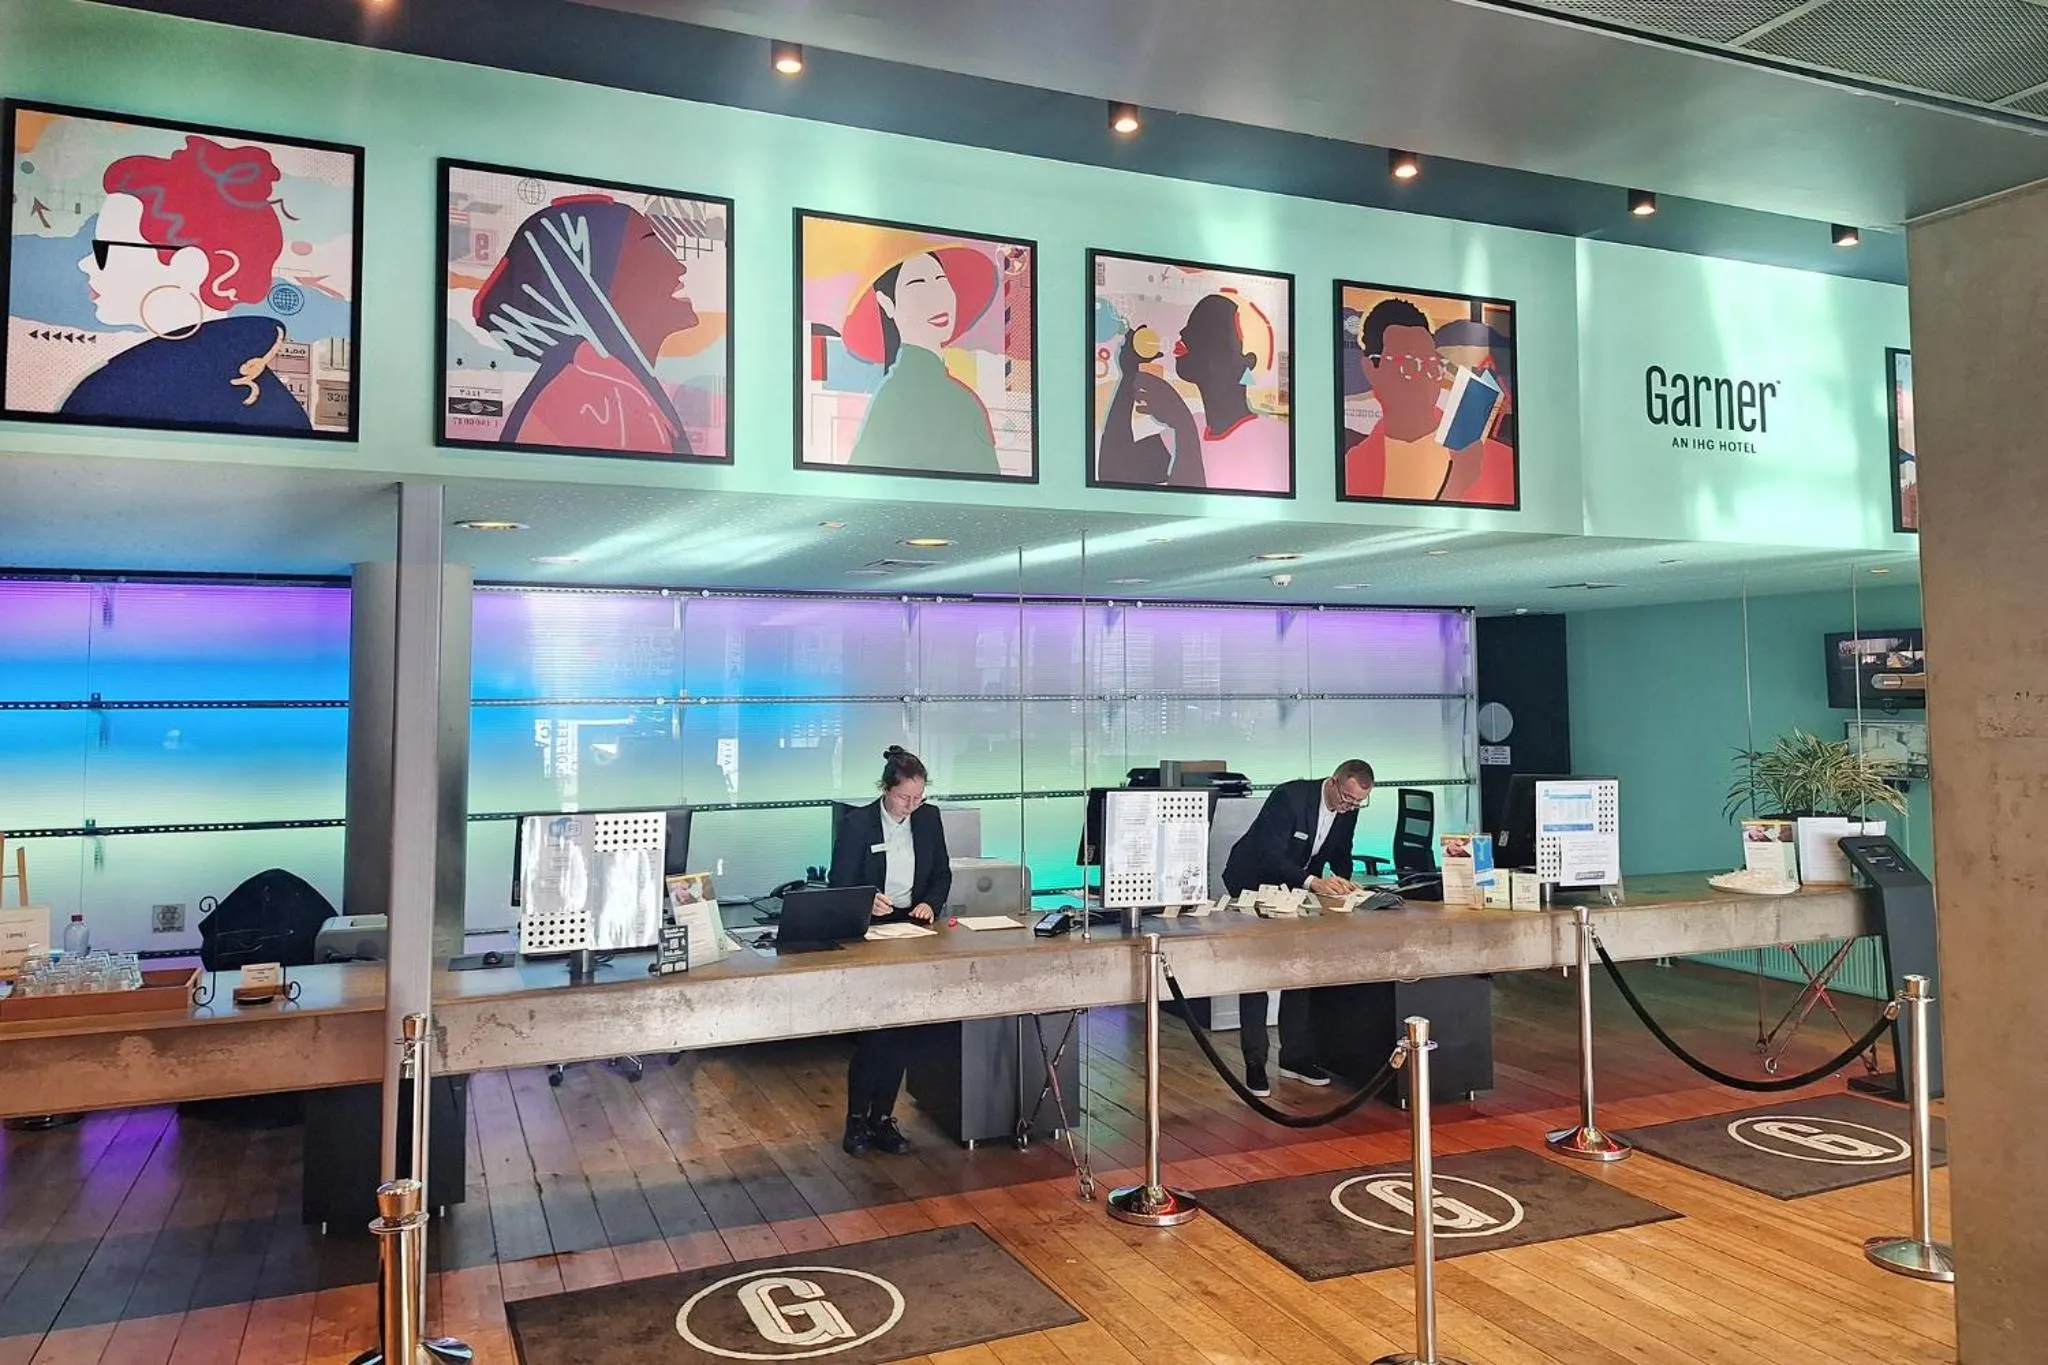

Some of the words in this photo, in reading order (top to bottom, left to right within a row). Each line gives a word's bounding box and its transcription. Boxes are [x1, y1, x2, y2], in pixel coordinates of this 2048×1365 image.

[1645, 365, 1777, 433] Garner
[1672, 437, 1689, 449] AN
[1692, 438, 1715, 450] IHG
[1719, 441, 1757, 454] HOTEL
[1752, 1121, 1896, 1157] G
[737, 1277, 857, 1346] G
